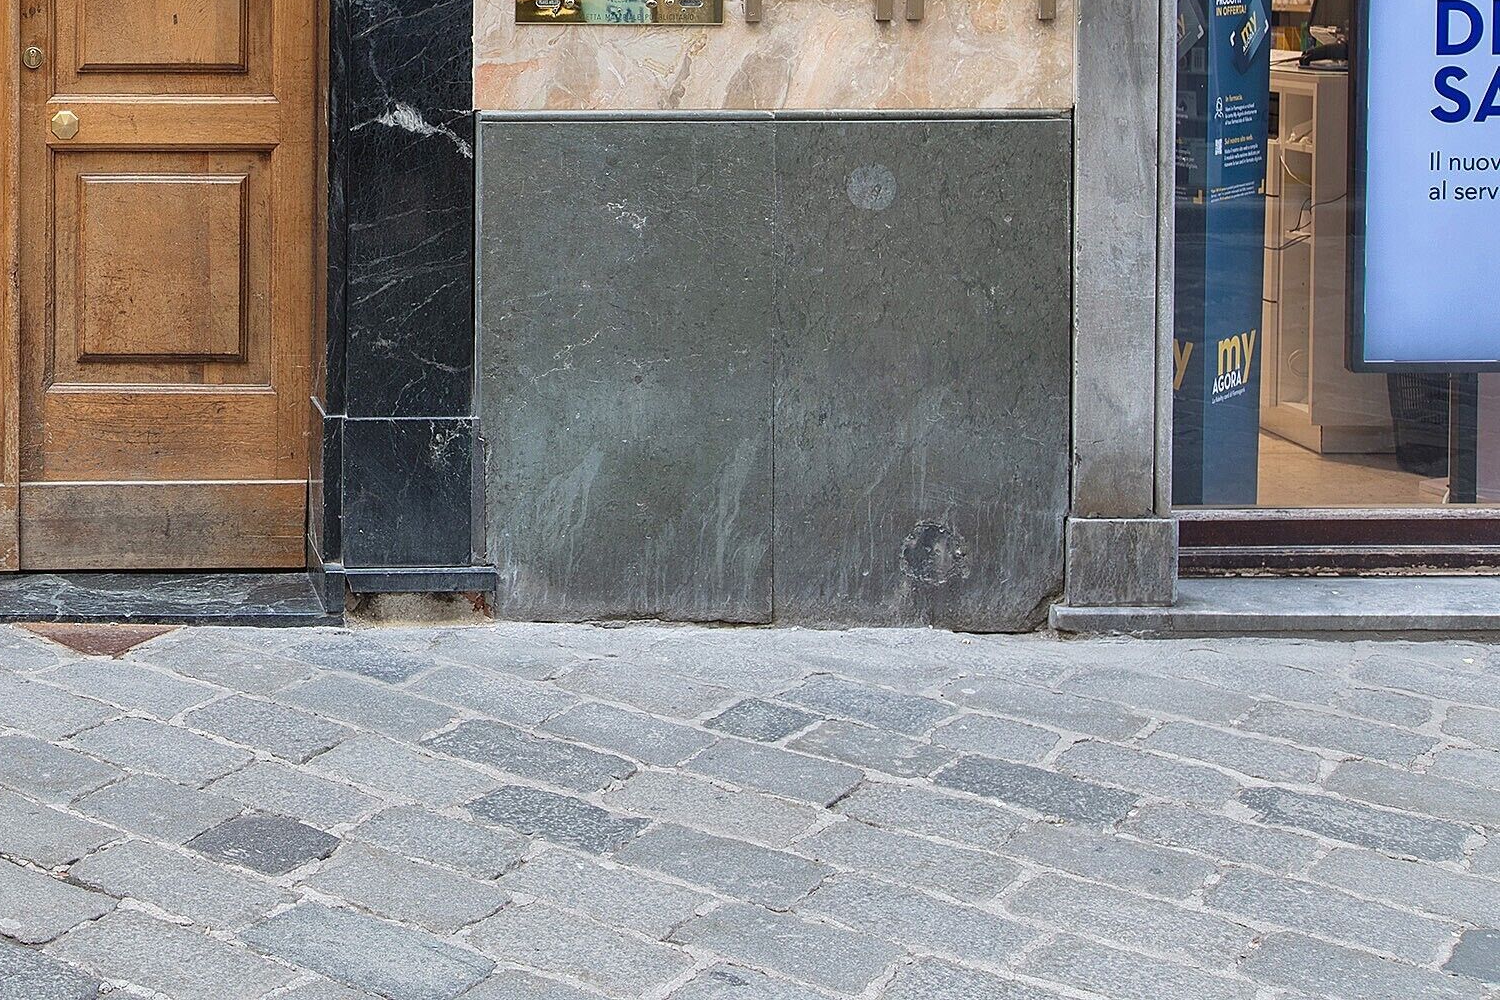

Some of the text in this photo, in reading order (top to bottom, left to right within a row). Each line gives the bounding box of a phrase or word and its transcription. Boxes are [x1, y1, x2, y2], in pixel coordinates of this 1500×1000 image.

[1215, 4, 1247, 16] IN OFFERTA!
[1429, 152, 1441, 171] Il
[1428, 180, 1500, 200] al serv
[1217, 329, 1257, 384] my
